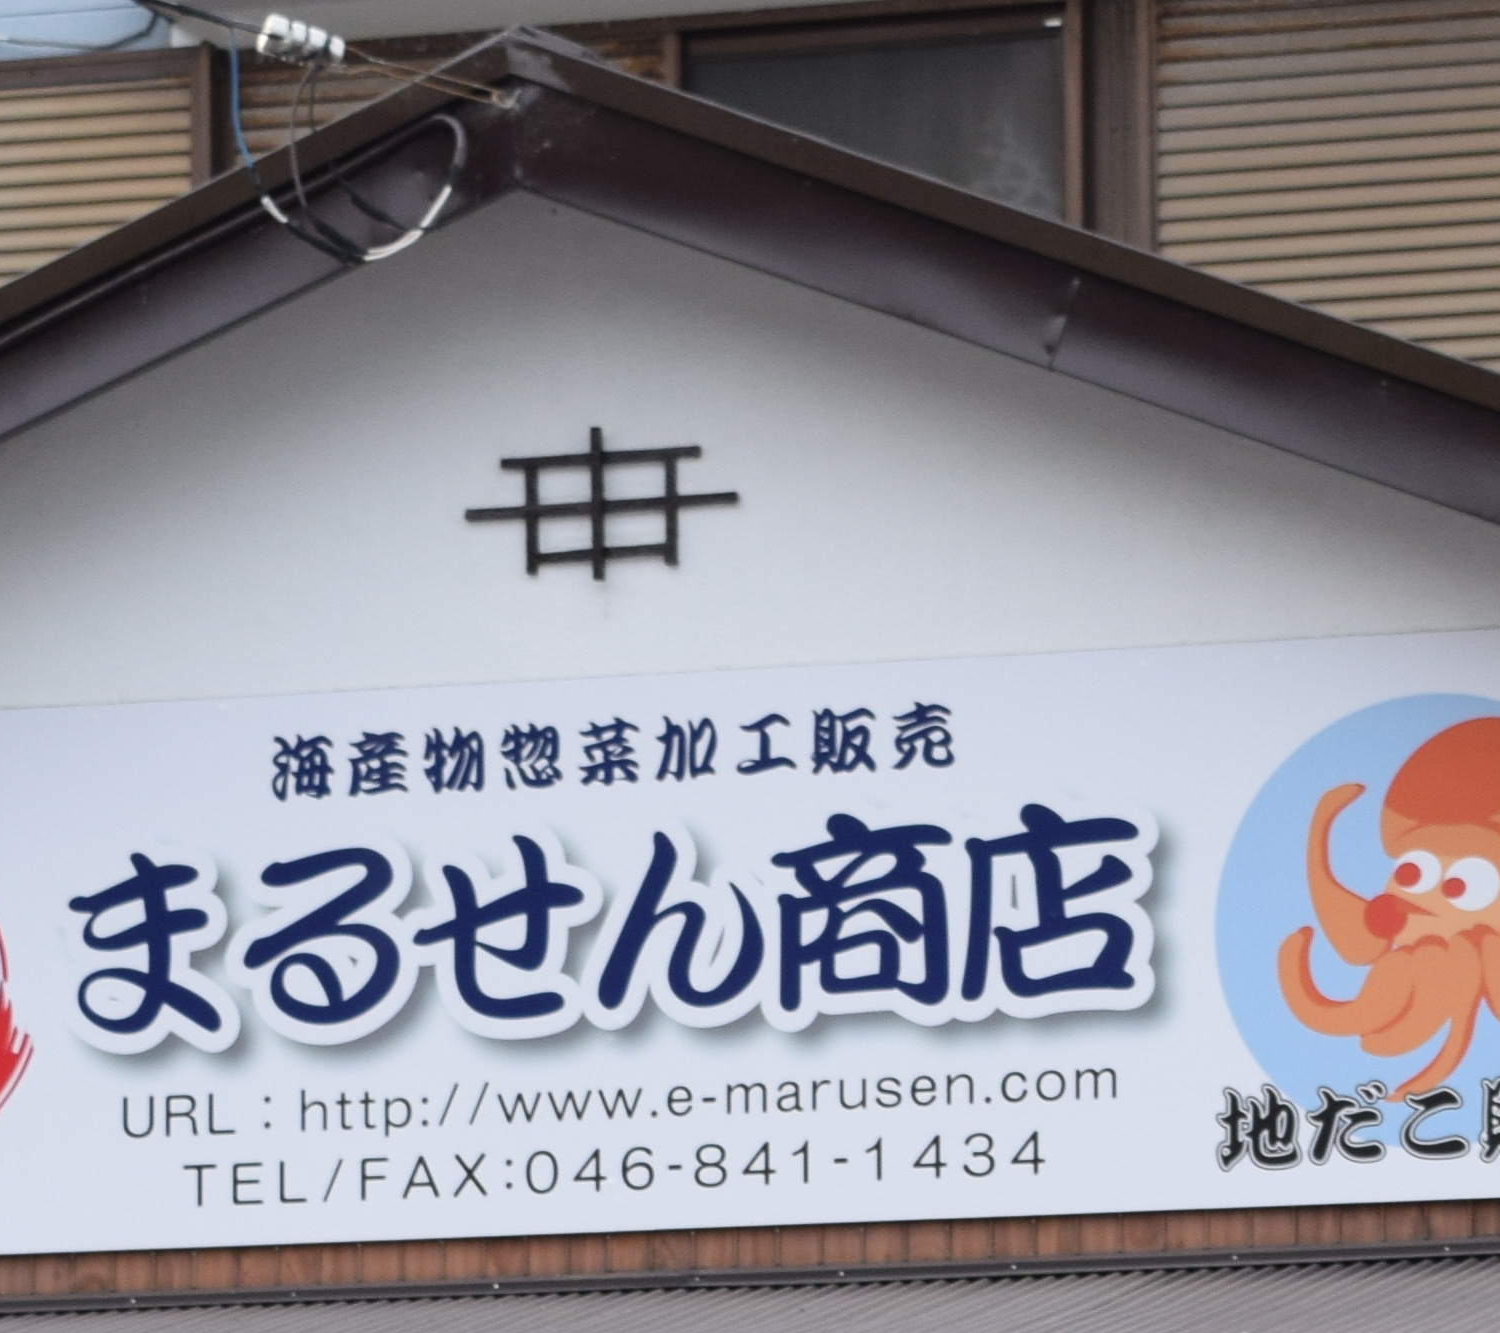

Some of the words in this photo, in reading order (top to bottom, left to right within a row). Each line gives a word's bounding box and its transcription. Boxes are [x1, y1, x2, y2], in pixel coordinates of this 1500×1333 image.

[269, 701, 956, 801] 海産物惣菜加工販売
[67, 801, 1142, 1036] まるせん商店
